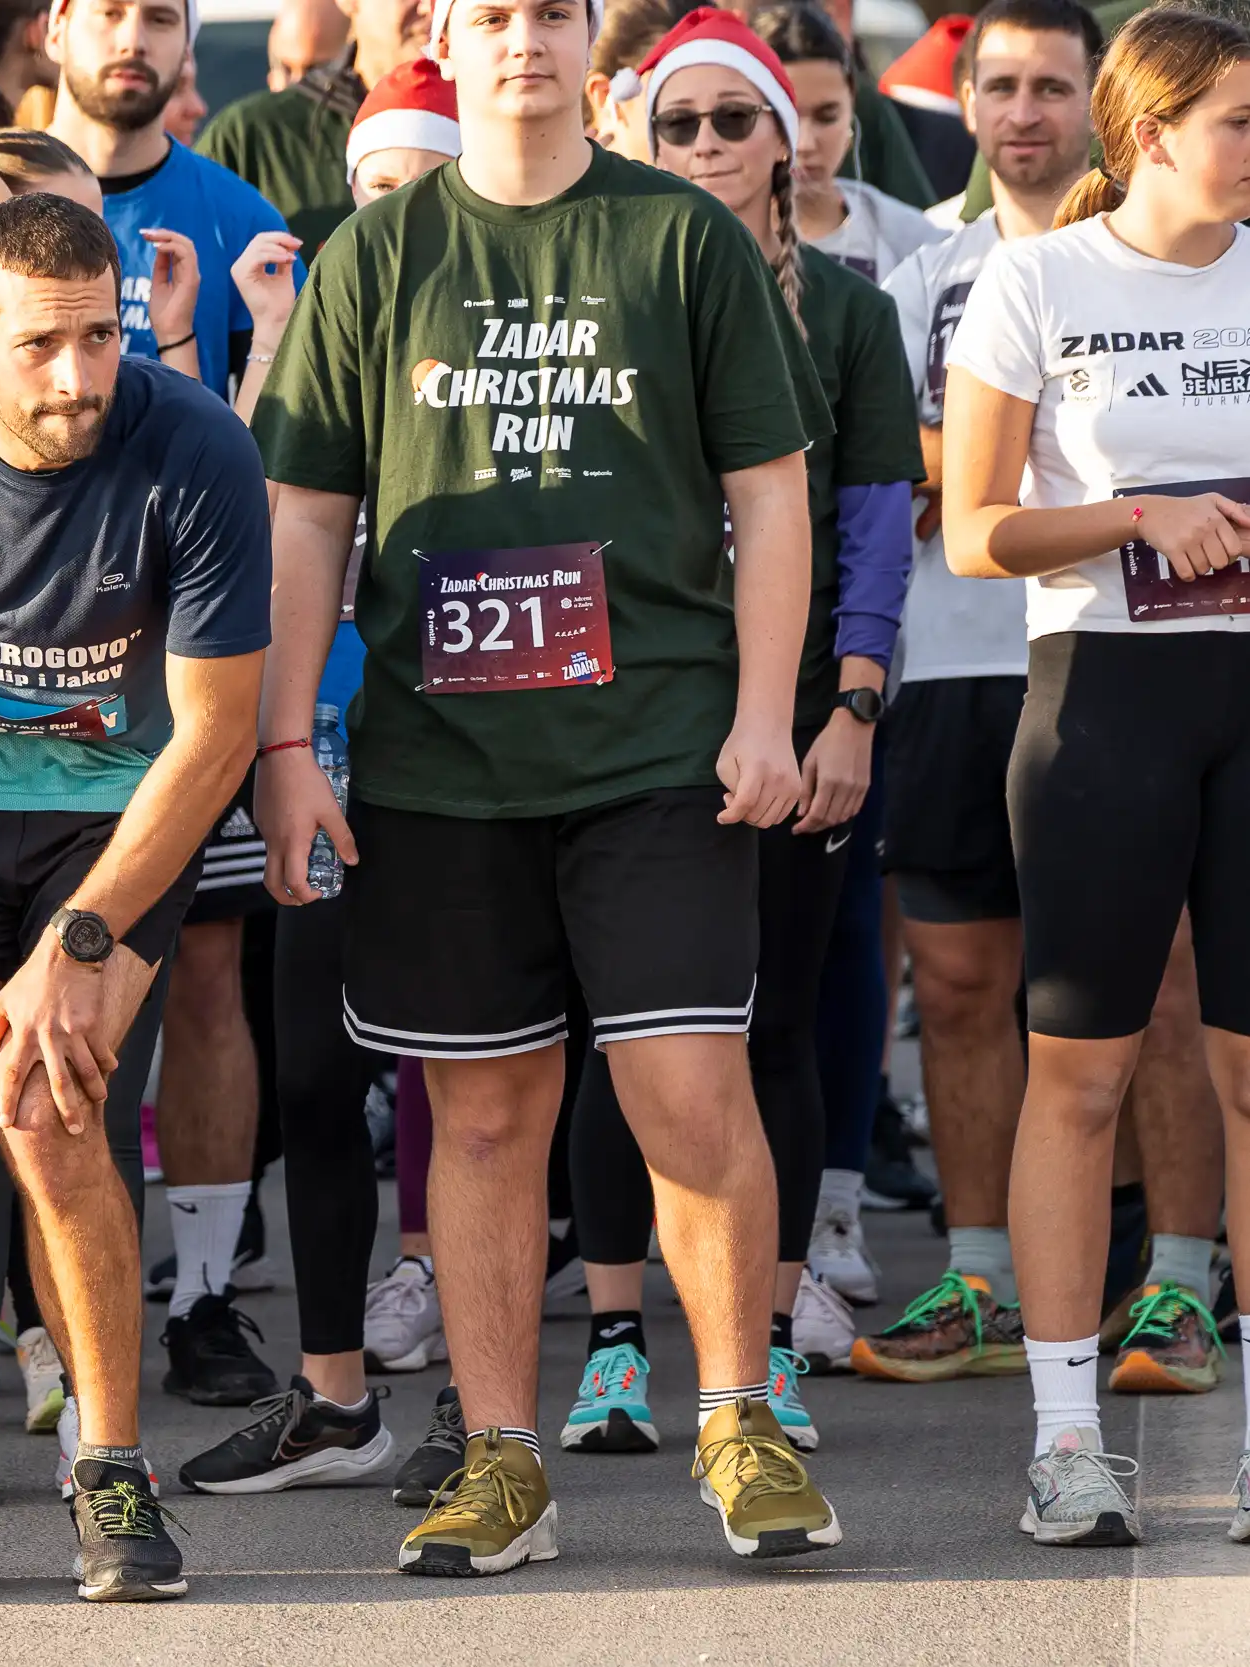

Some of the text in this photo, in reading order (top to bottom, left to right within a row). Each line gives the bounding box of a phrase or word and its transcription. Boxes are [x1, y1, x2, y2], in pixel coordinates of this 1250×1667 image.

[477, 318, 599, 359] ZADAR
[1062, 327, 1250, 358] ZADAR 20
[422, 367, 638, 408] CHRISTMAS
[492, 412, 574, 454] RUN
[96, 581, 131, 594] Kalenji
[441, 570, 581, 593] ZADAR CHRISTMAS RUN
[442, 596, 544, 653] 321
[39, 673, 46, 687] i
[56, 663, 124, 688] Jakov
[49, 721, 78, 731] RUN
